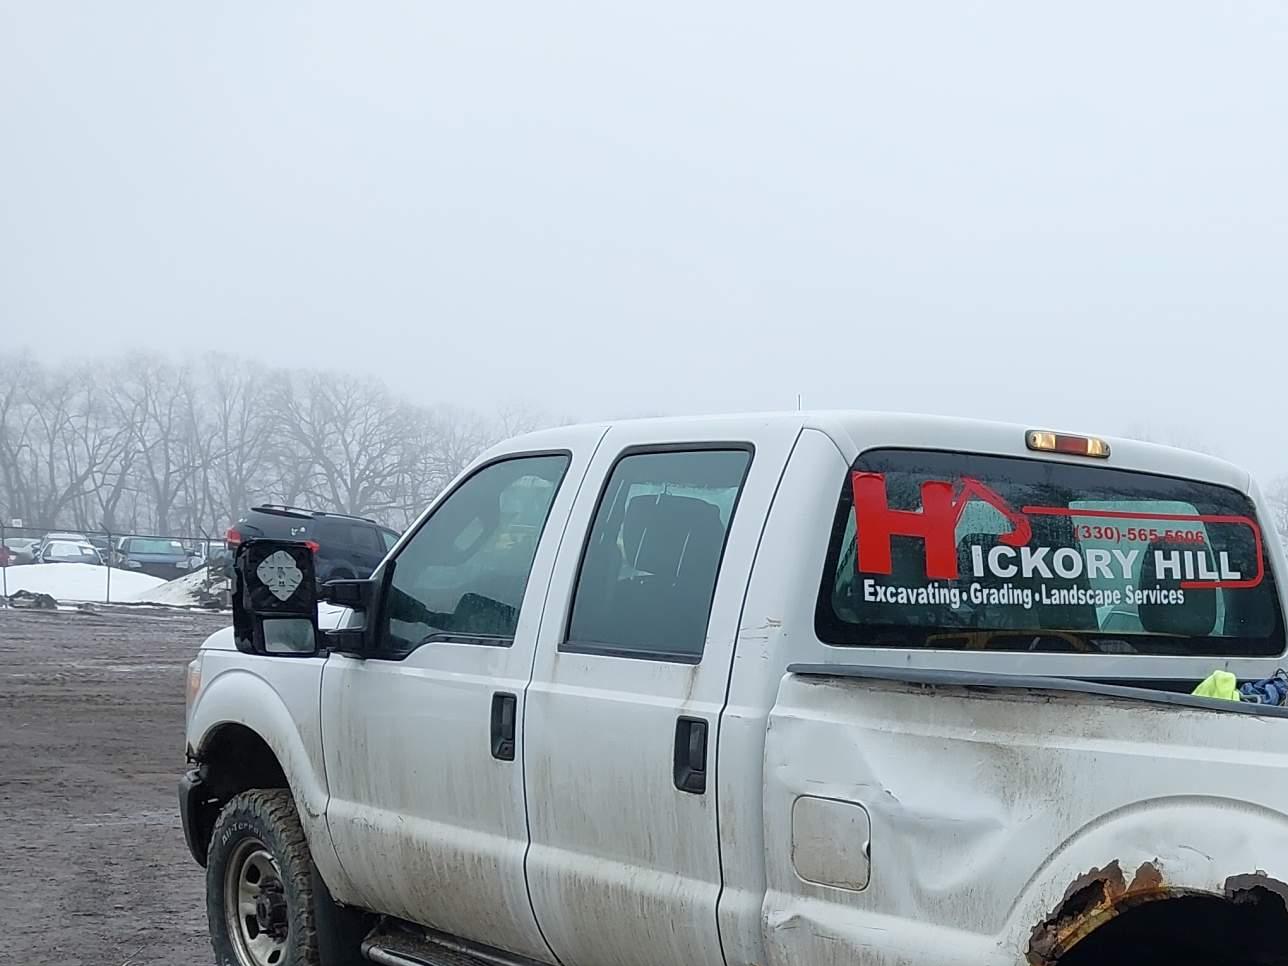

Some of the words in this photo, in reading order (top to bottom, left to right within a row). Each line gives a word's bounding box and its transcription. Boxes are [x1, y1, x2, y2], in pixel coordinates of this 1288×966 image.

[1154, 550, 1241, 580] HILL
[863, 578, 960, 609] Excavating
[970, 582, 1032, 609] Grading
[1041, 583, 1121, 607] Landscape
[1125, 585, 1185, 605] Services
